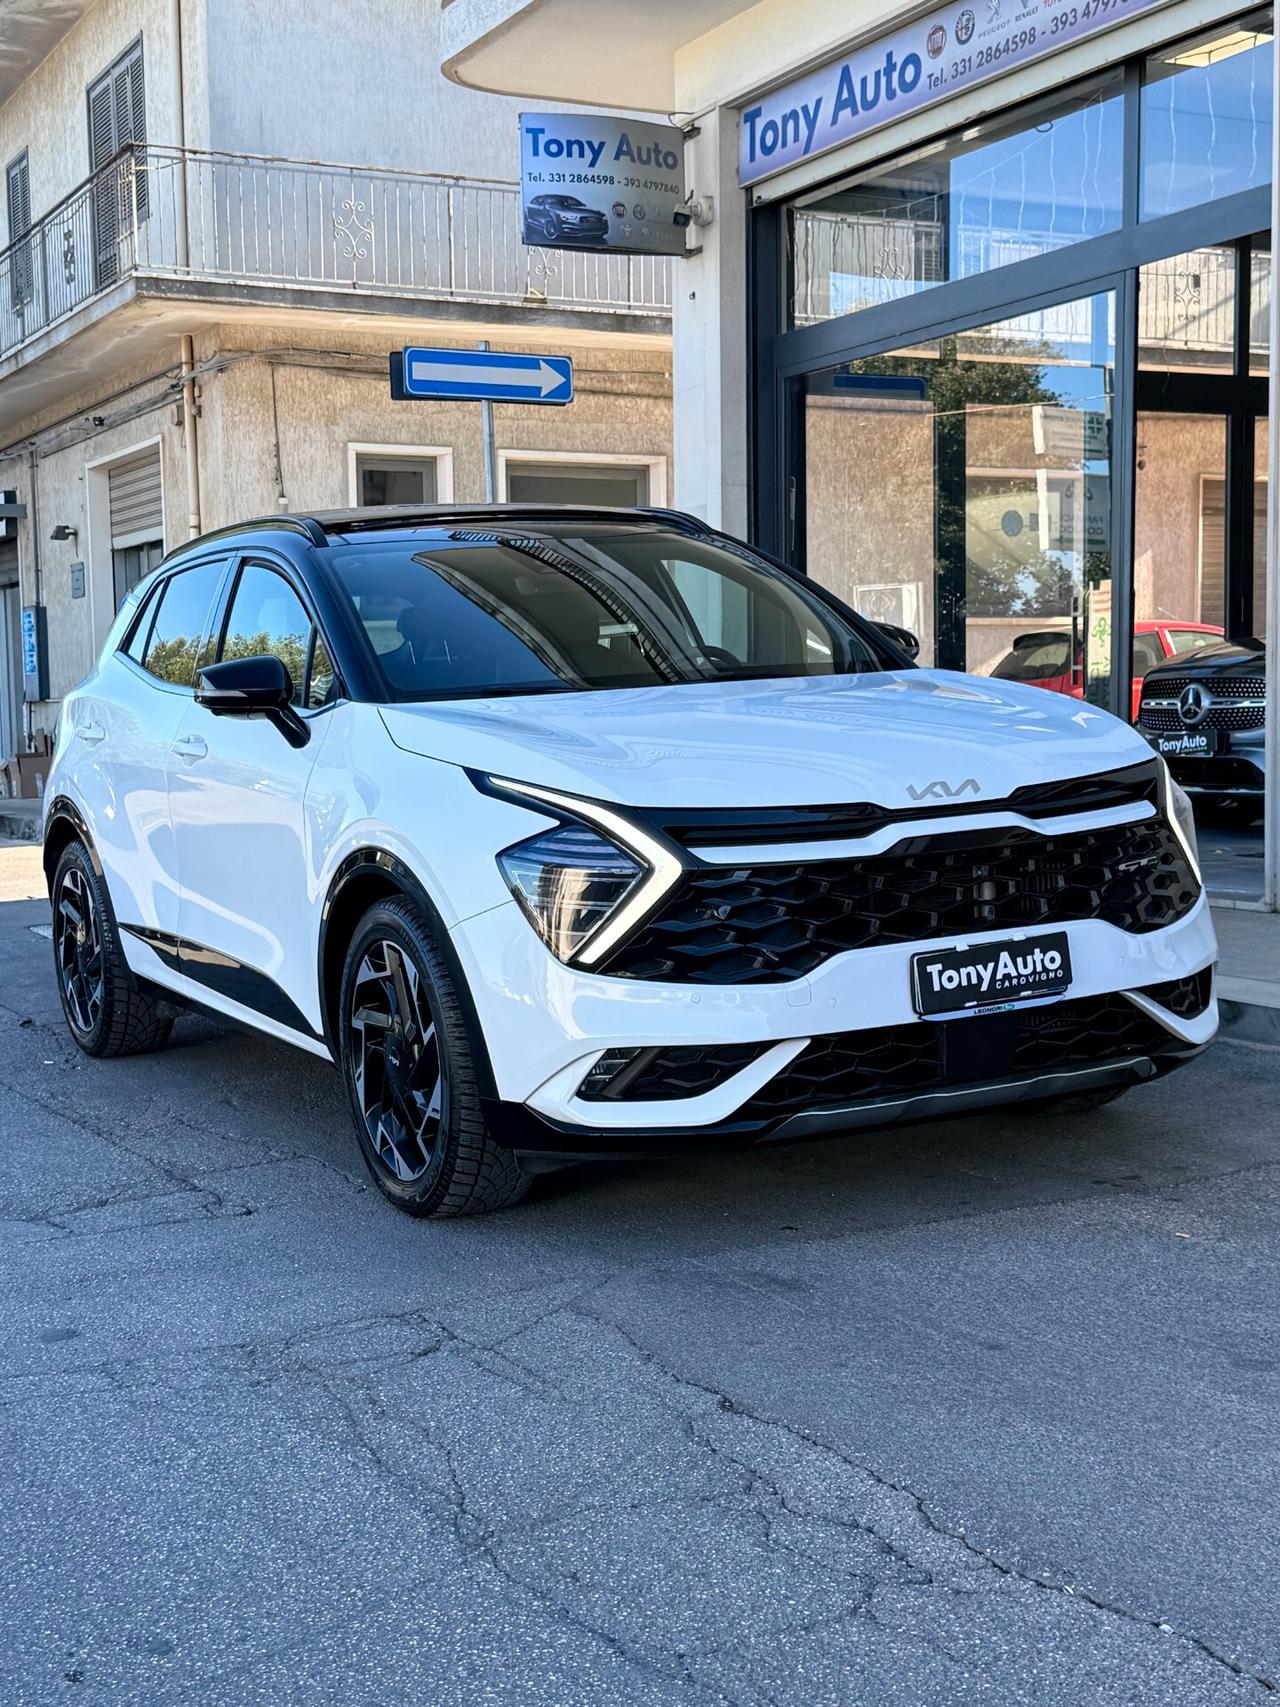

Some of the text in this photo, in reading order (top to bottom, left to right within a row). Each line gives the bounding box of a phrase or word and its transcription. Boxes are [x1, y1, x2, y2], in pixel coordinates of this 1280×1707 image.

[927, 68, 948, 90] Tel.
[951, 56, 972, 80] 331
[976, 26, 1036, 69] 2864598
[1051, 8, 1077, 35] 393
[743, 50, 922, 163] Tony Auto
[525, 128, 678, 170] Tony Auto
[527, 172, 545, 183] Tel.
[548, 173, 566, 183] 331
[569, 173, 615, 185] 2864598
[624, 177, 640, 188] 393
[642, 180, 680, 195] 4797840
[926, 948, 1062, 992] TonyAuto
[995, 969, 1064, 990] CAROVIGNO
